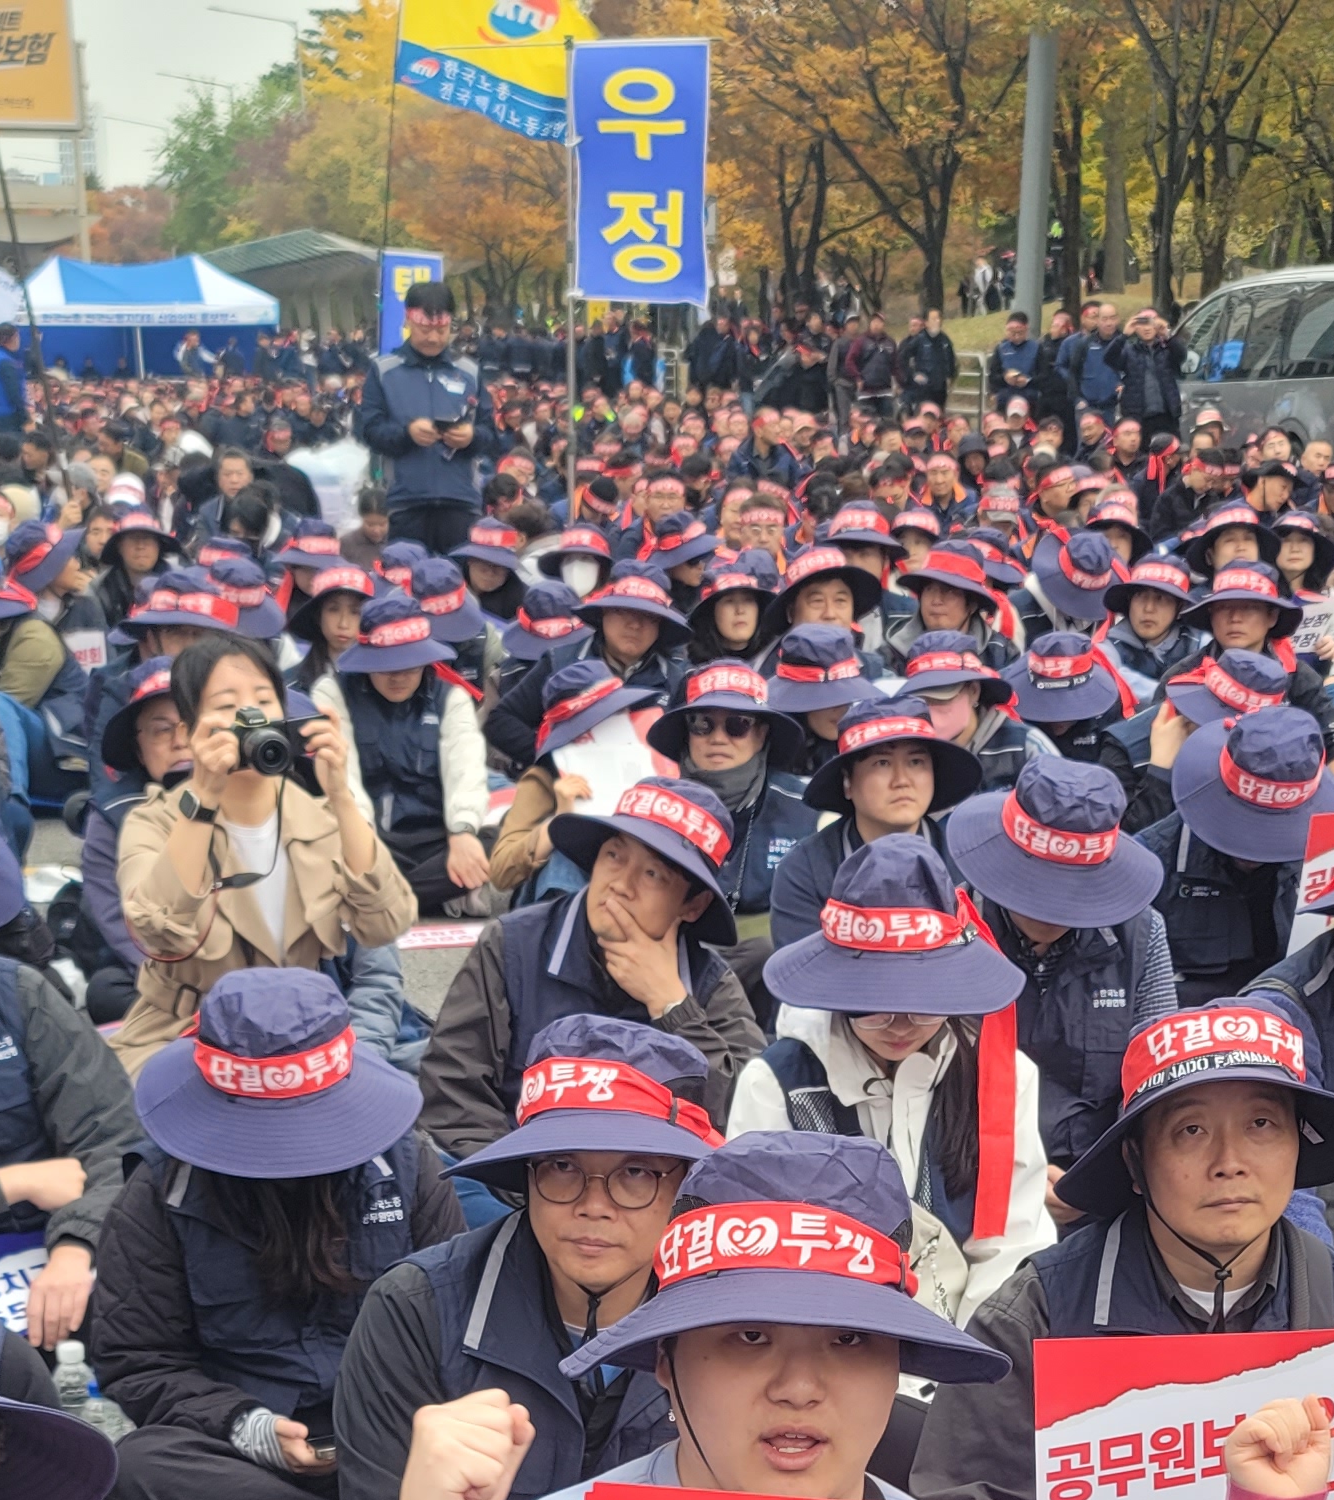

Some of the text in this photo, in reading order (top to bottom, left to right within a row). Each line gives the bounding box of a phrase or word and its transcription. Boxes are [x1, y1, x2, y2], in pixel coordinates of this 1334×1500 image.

[444, 59, 511, 100] 한국노총
[700, 670, 731, 693] 단결
[1238, 772, 1276, 805] 단결
[618, 787, 654, 820] 단결
[679, 809, 723, 853] 투쟁
[1013, 813, 1049, 856] 단결
[886, 910, 944, 948] 투쟁
[1093, 998, 1127, 1009] 공무원연맹
[1100, 989, 1126, 998] 한국노총
[1146, 1011, 1306, 1072] 단결 투쟁
[209, 1040, 351, 1090] 단결 투쟁
[545, 1060, 618, 1102] 투쟁
[659, 1211, 876, 1280] 단결 투쟁
